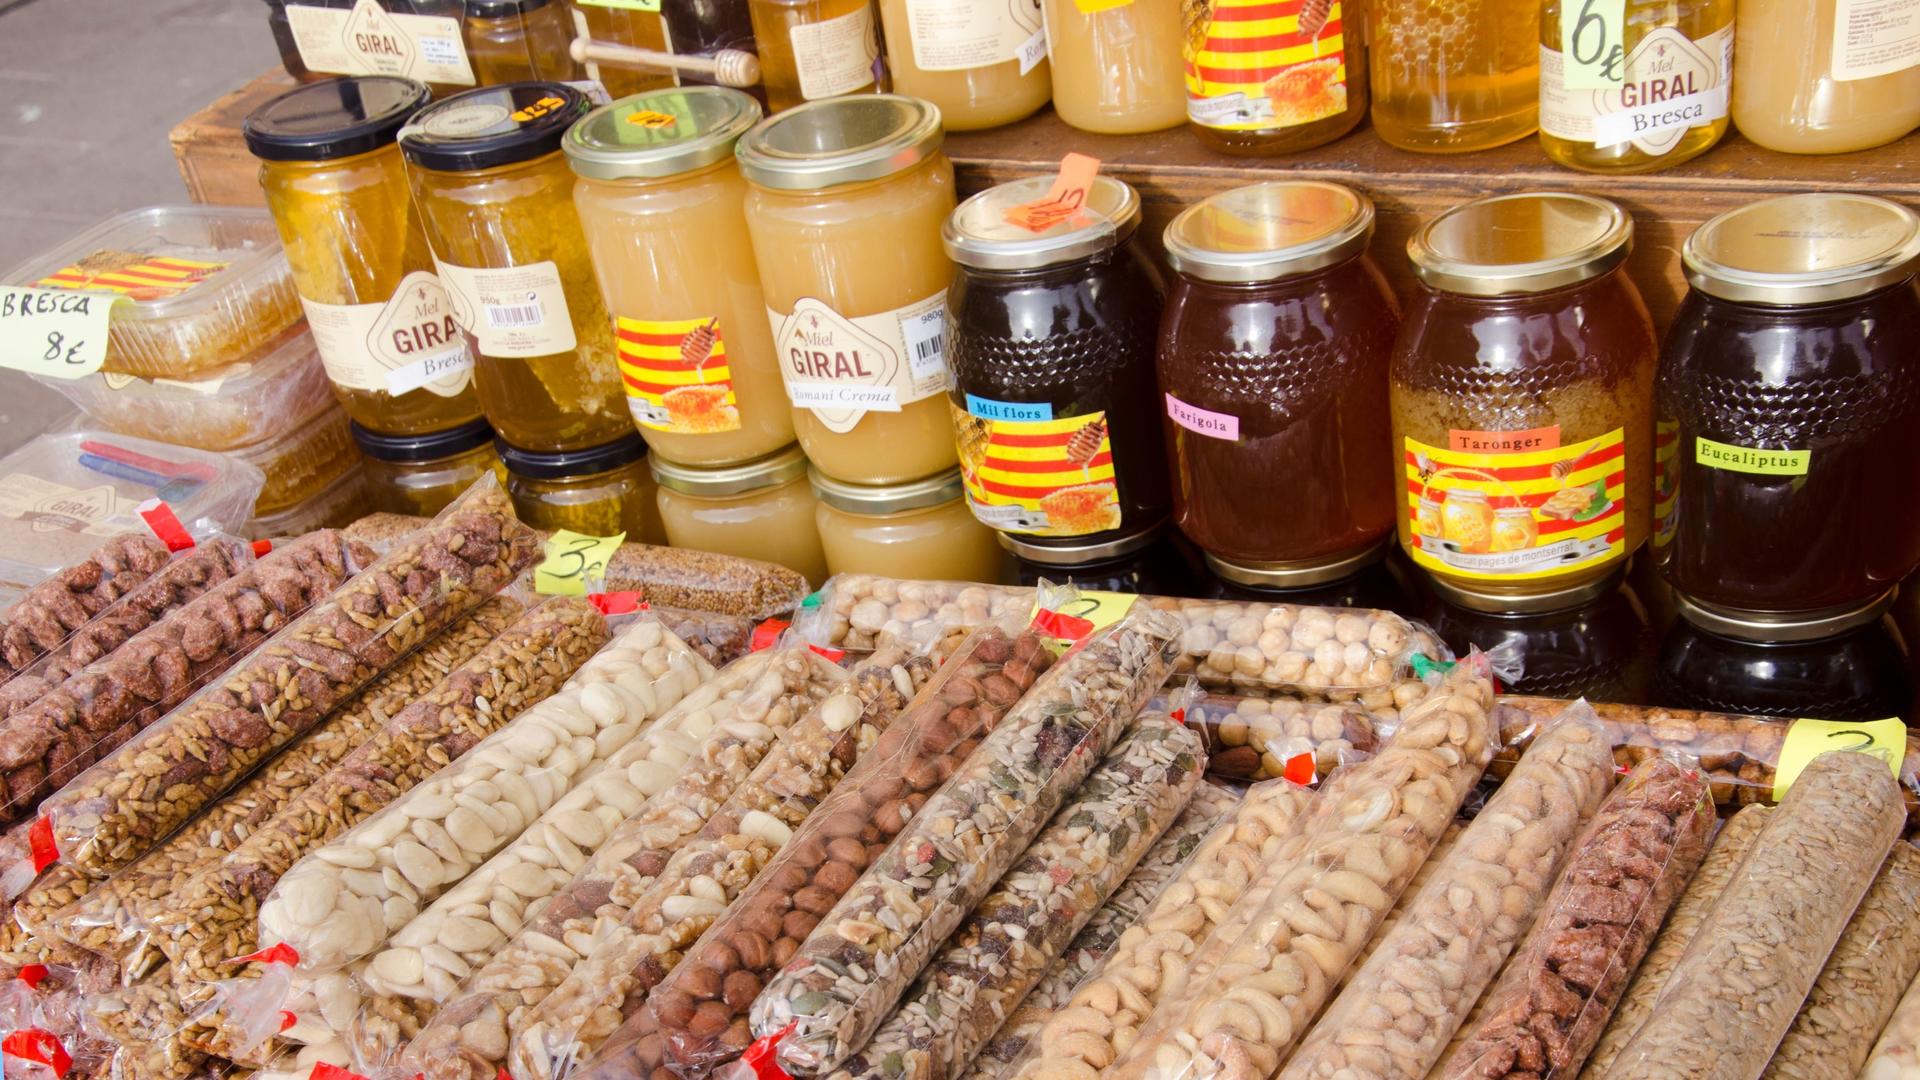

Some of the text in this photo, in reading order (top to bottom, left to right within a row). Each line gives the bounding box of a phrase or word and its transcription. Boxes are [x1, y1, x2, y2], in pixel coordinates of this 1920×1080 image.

[356, 33, 404, 57] GIRAL
[1648, 56, 1675, 75] Mel
[1621, 70, 1699, 108] GIRAL
[1632, 103, 1703, 132] Bresca
[3, 293, 90, 317] BRESCA
[416, 297, 439, 319] Mel
[392, 314, 457, 353] GIRA
[44, 331, 86, 364] 8€
[791, 347, 872, 378] GIRAL
[839, 389, 891, 402] Crema
[976, 402, 1041, 419] Mil flors
[1173, 404, 1227, 432] Farigola
[1459, 436, 1543, 450] Taronger
[1700, 443, 1800, 468] Eucaliptus
[51, 500, 100, 518] GIRAL
[1509, 553, 1520, 564] de
[1522, 542, 1574, 561] montserrat
